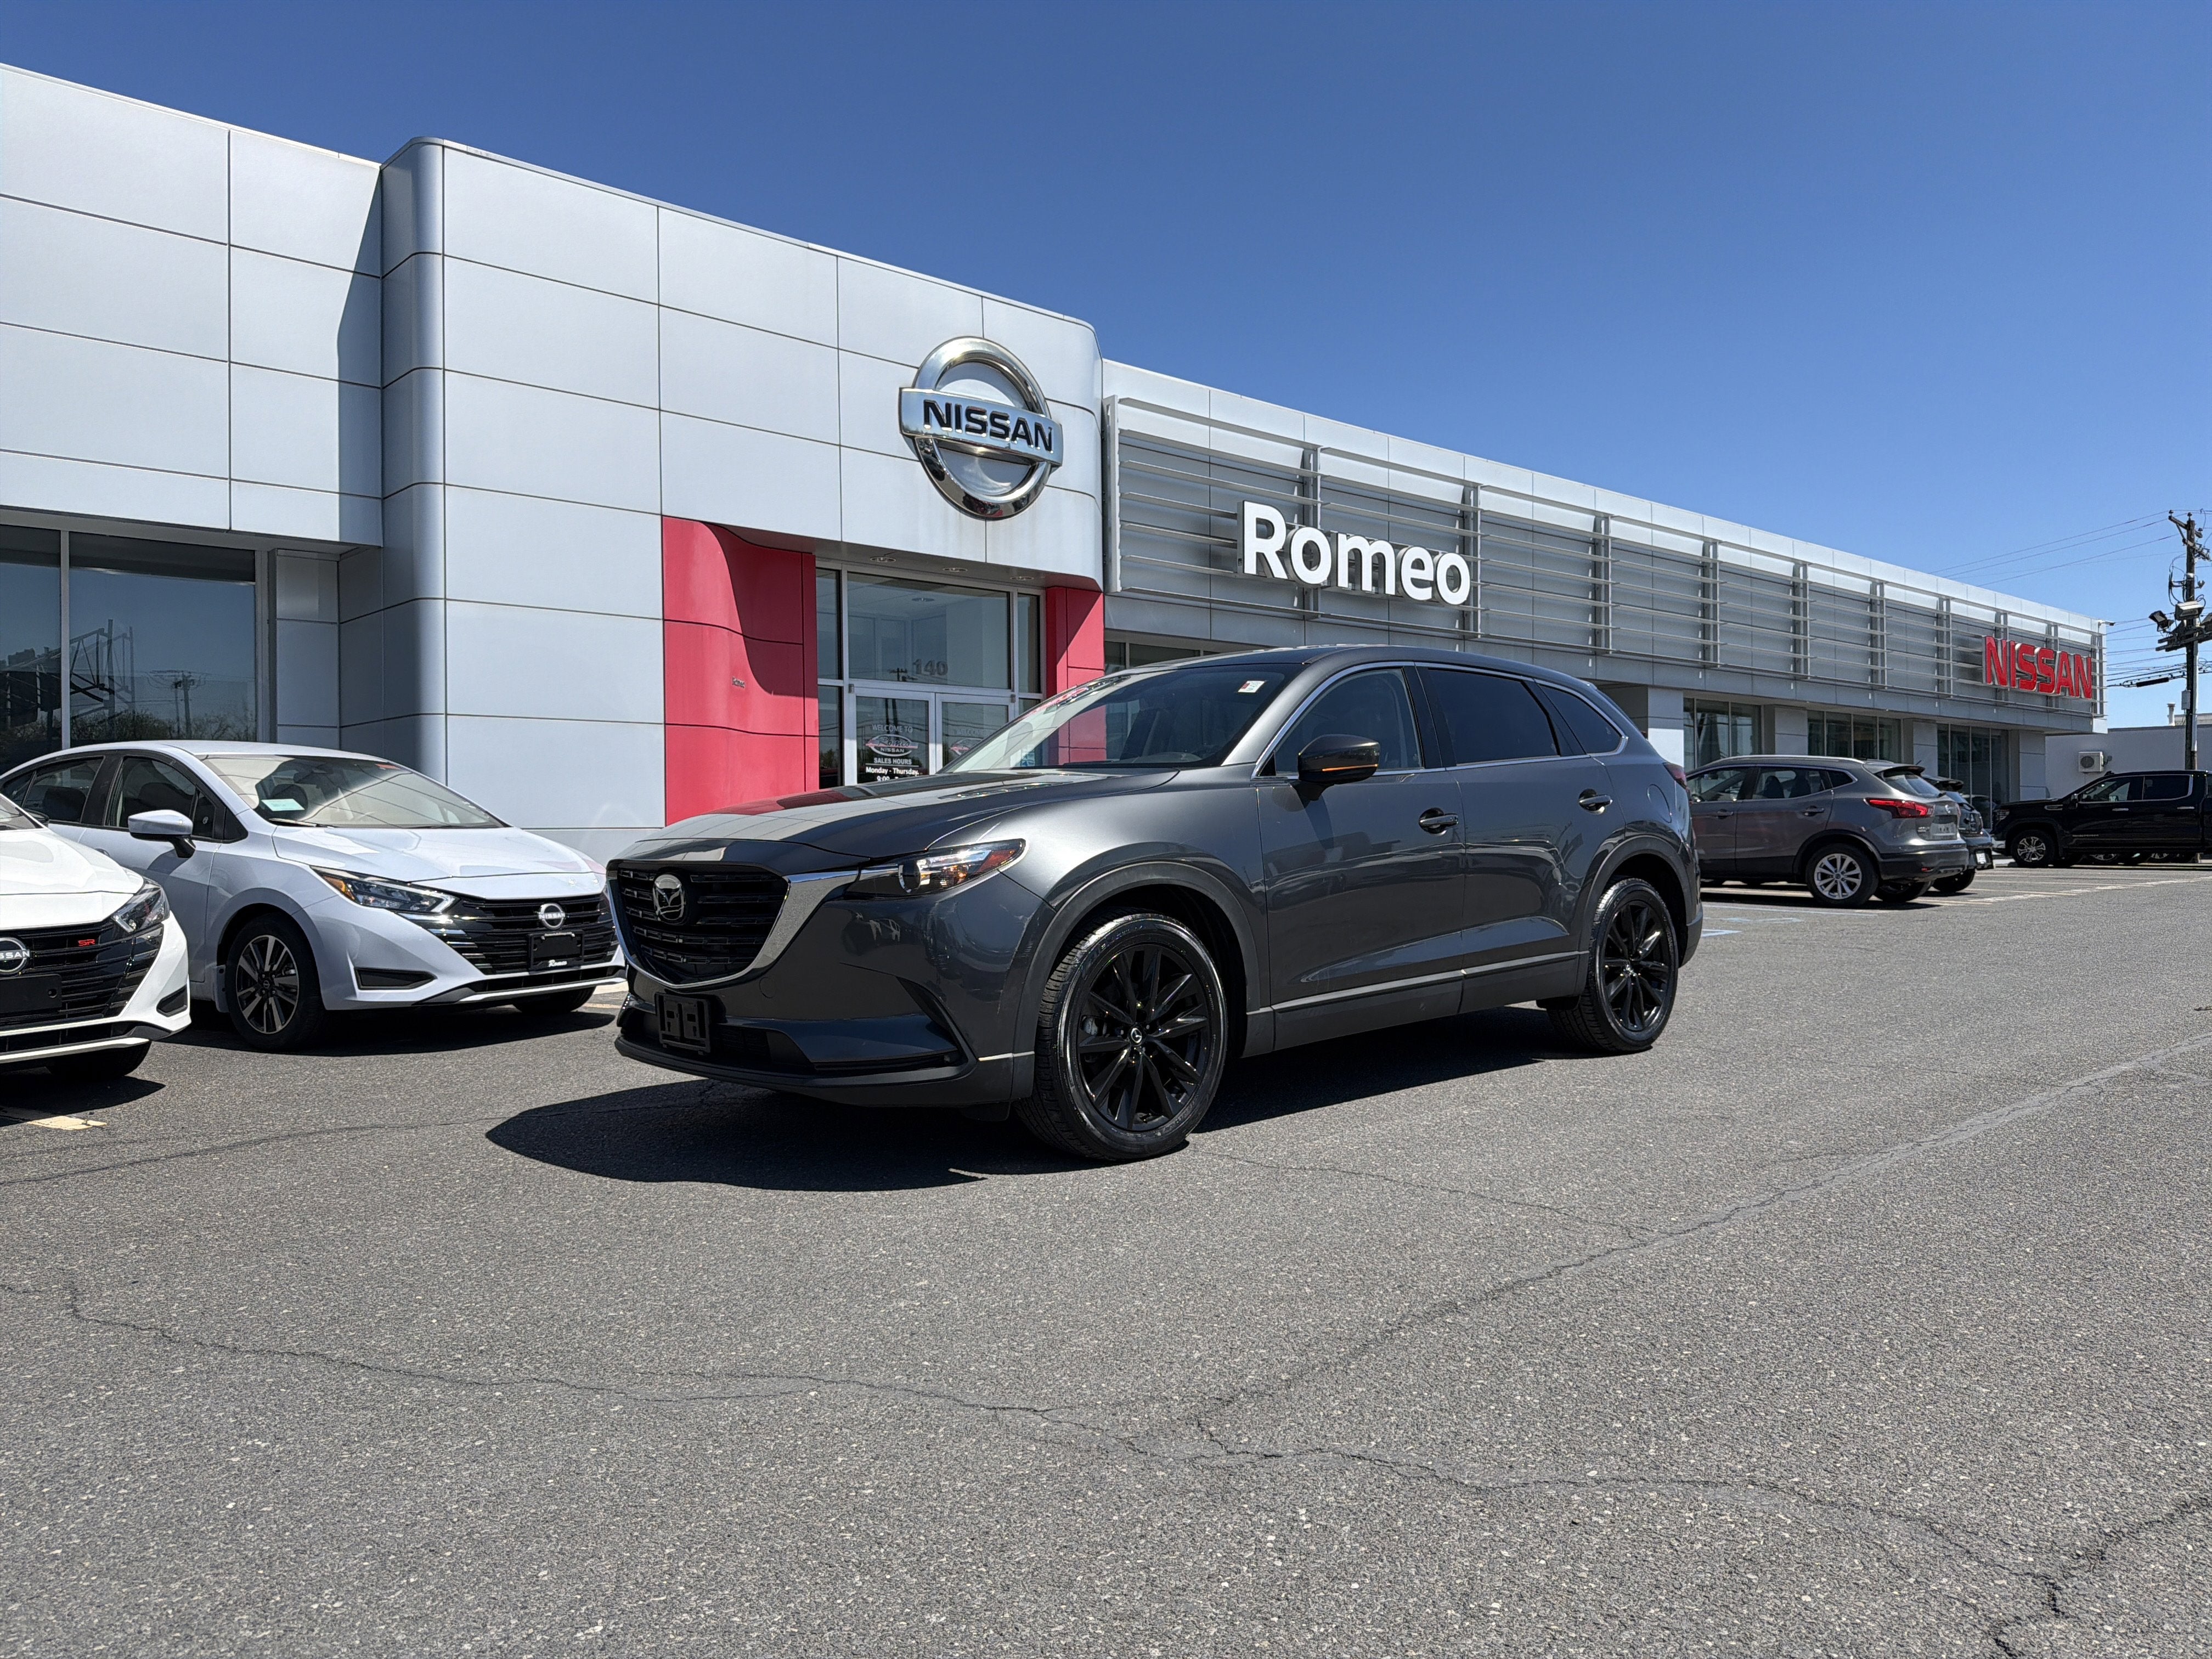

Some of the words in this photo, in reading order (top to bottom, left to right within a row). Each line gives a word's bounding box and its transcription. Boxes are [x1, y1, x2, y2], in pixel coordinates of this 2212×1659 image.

[923, 399, 1052, 454] NISSAN
[1240, 500, 1472, 605] Romeo
[913, 659, 948, 675] 140
[1984, 635, 2092, 699] NISSAN
[877, 736, 910, 747] Romeo
[866, 766, 888, 775] Monday
